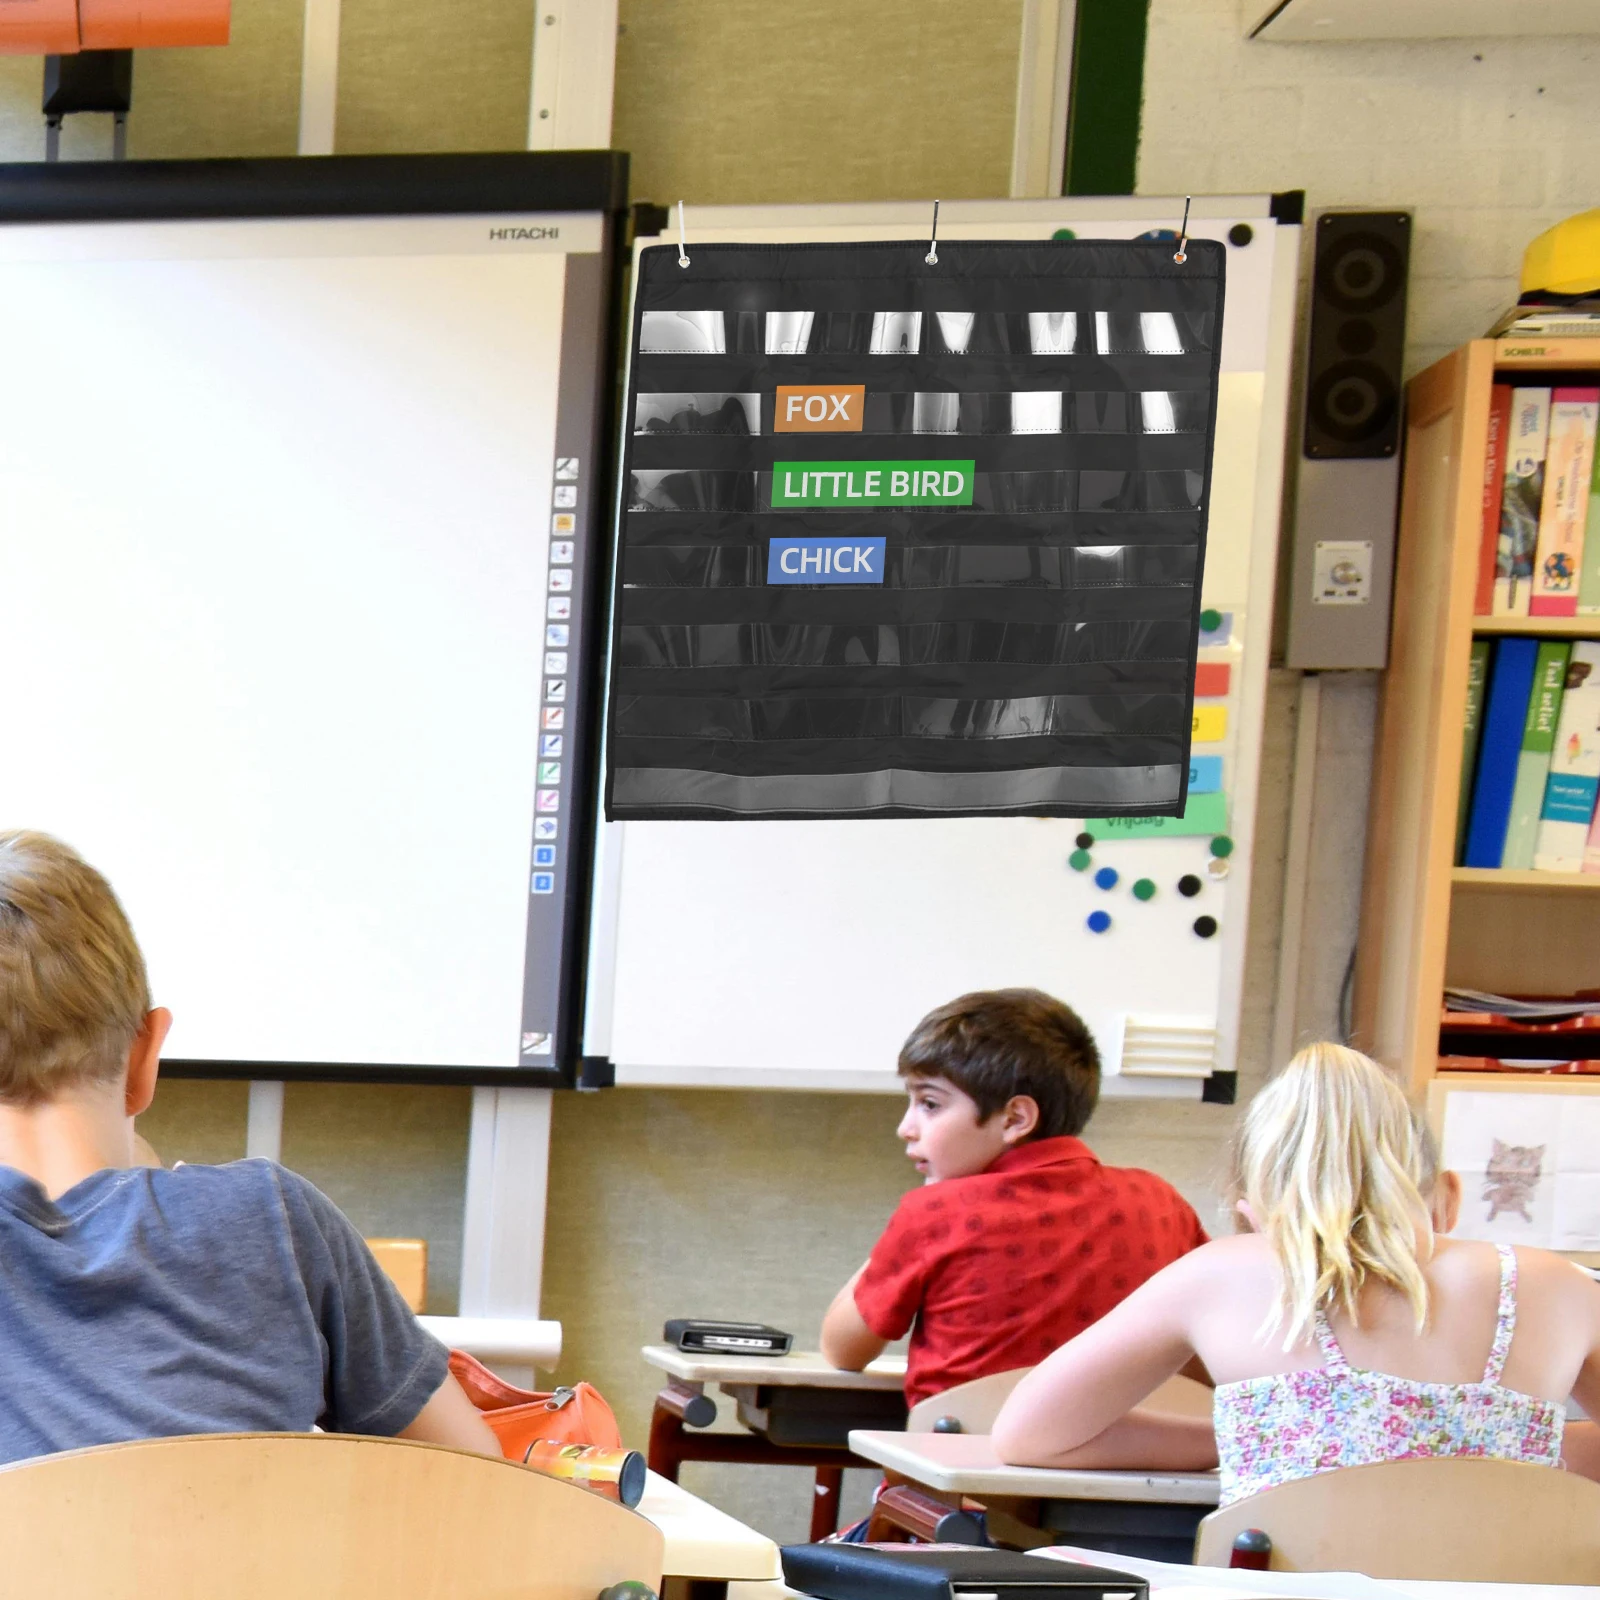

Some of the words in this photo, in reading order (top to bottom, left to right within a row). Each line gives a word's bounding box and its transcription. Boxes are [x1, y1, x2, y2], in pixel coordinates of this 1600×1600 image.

[489, 227, 559, 240] HITACHI
[786, 394, 852, 422] FOX
[784, 470, 882, 498] LITTLE
[890, 470, 965, 497] BIRD
[780, 546, 875, 574] CHICK
[1544, 658, 1563, 688] Taal
[1537, 692, 1555, 733] actief
